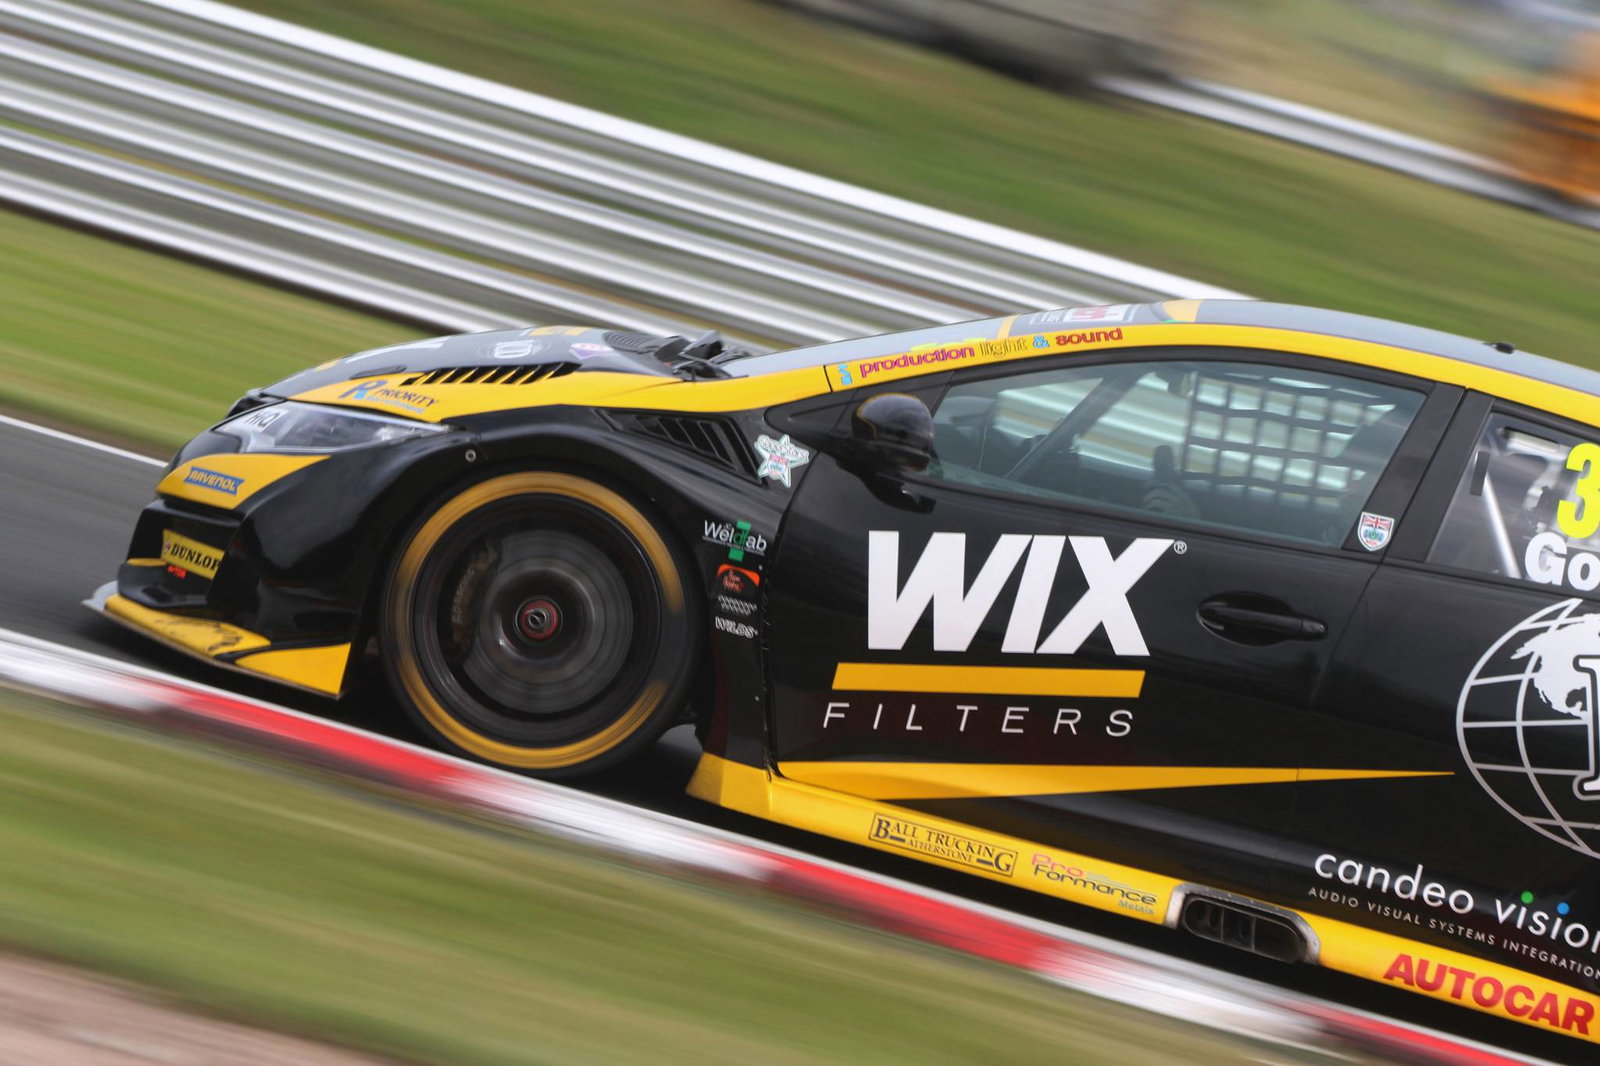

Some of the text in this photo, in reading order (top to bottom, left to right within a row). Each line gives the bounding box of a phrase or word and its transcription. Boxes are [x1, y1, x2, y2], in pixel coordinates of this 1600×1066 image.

[860, 346, 975, 378] production
[980, 339, 1028, 358] light
[1055, 327, 1123, 347] sound
[374, 386, 438, 408] PRIORITY
[188, 469, 236, 492] RAVENOL
[868, 530, 1175, 656] WIX
[823, 702, 1134, 737] FILTERS
[873, 818, 1015, 875] BALL TRUCKING
[905, 837, 976, 864] ATHERSTONE
[1314, 853, 1474, 915] candeo
[1308, 887, 1359, 908] AUDIO
[1366, 901, 1422, 926] VISUAL
[1428, 918, 1496, 946] SYSTEMS
[1383, 953, 1596, 1036] AUTOCAR
